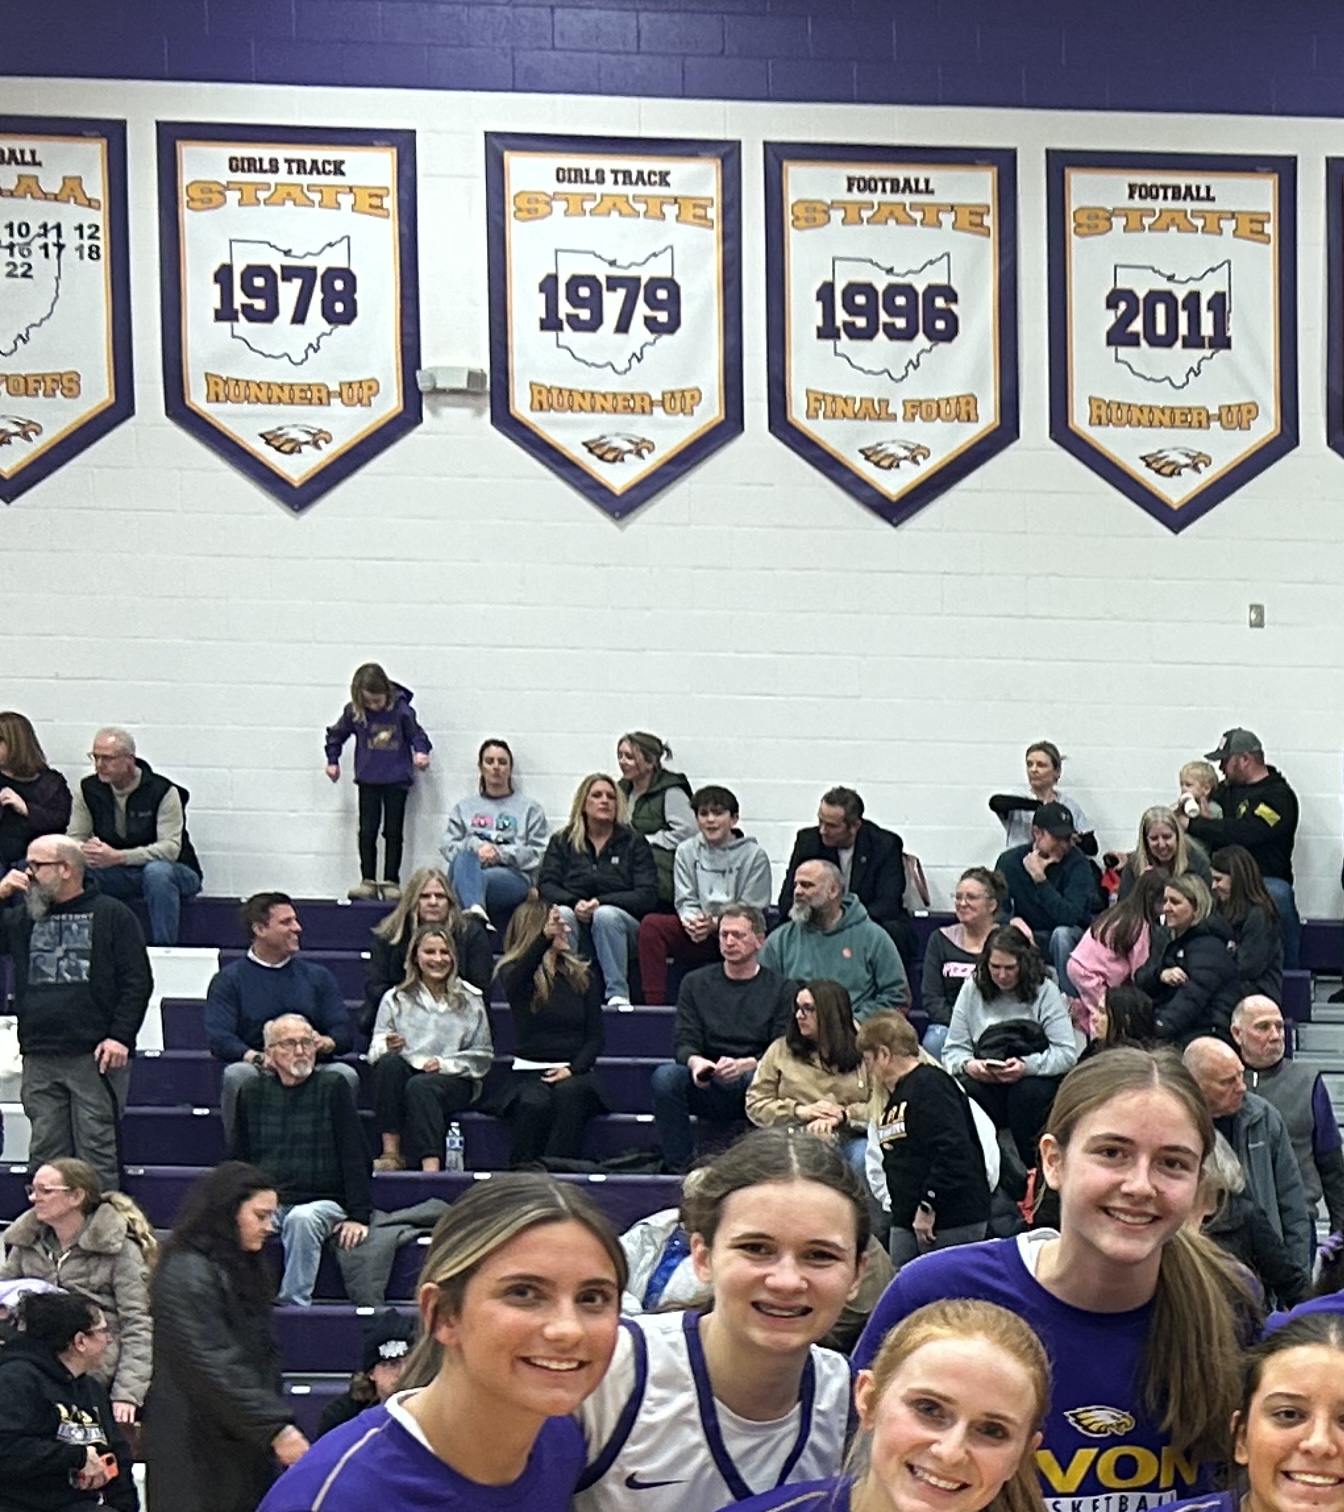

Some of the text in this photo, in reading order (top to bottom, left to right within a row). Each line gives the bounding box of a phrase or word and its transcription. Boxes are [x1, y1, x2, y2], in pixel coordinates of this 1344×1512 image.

[228, 155, 346, 177] GIRLS TRACK
[556, 166, 671, 188] GIRLS TRACK
[186, 181, 390, 219] STATE
[846, 176, 934, 195] FOOTBALL
[1128, 183, 1215, 202] FOOTBALL
[513, 191, 714, 229] STATE
[791, 199, 990, 237] STATE
[1073, 207, 1270, 244] STATE
[5, 222, 100, 240] 10 11 12
[75, 244, 100, 261] 18
[5, 262, 33, 279] 22
[213, 264, 358, 326] 1978
[538, 274, 682, 335] 1979
[816, 281, 958, 343] 1996
[1106, 288, 1232, 350] 2011
[206, 373, 380, 407] RUNNER-UP
[530, 382, 702, 416] RUNNER-UP
[806, 389, 979, 423] FINAL FOUR
[1089, 396, 1259, 430] RUNNER-UP
[1034, 1445, 1200, 1493] VON
